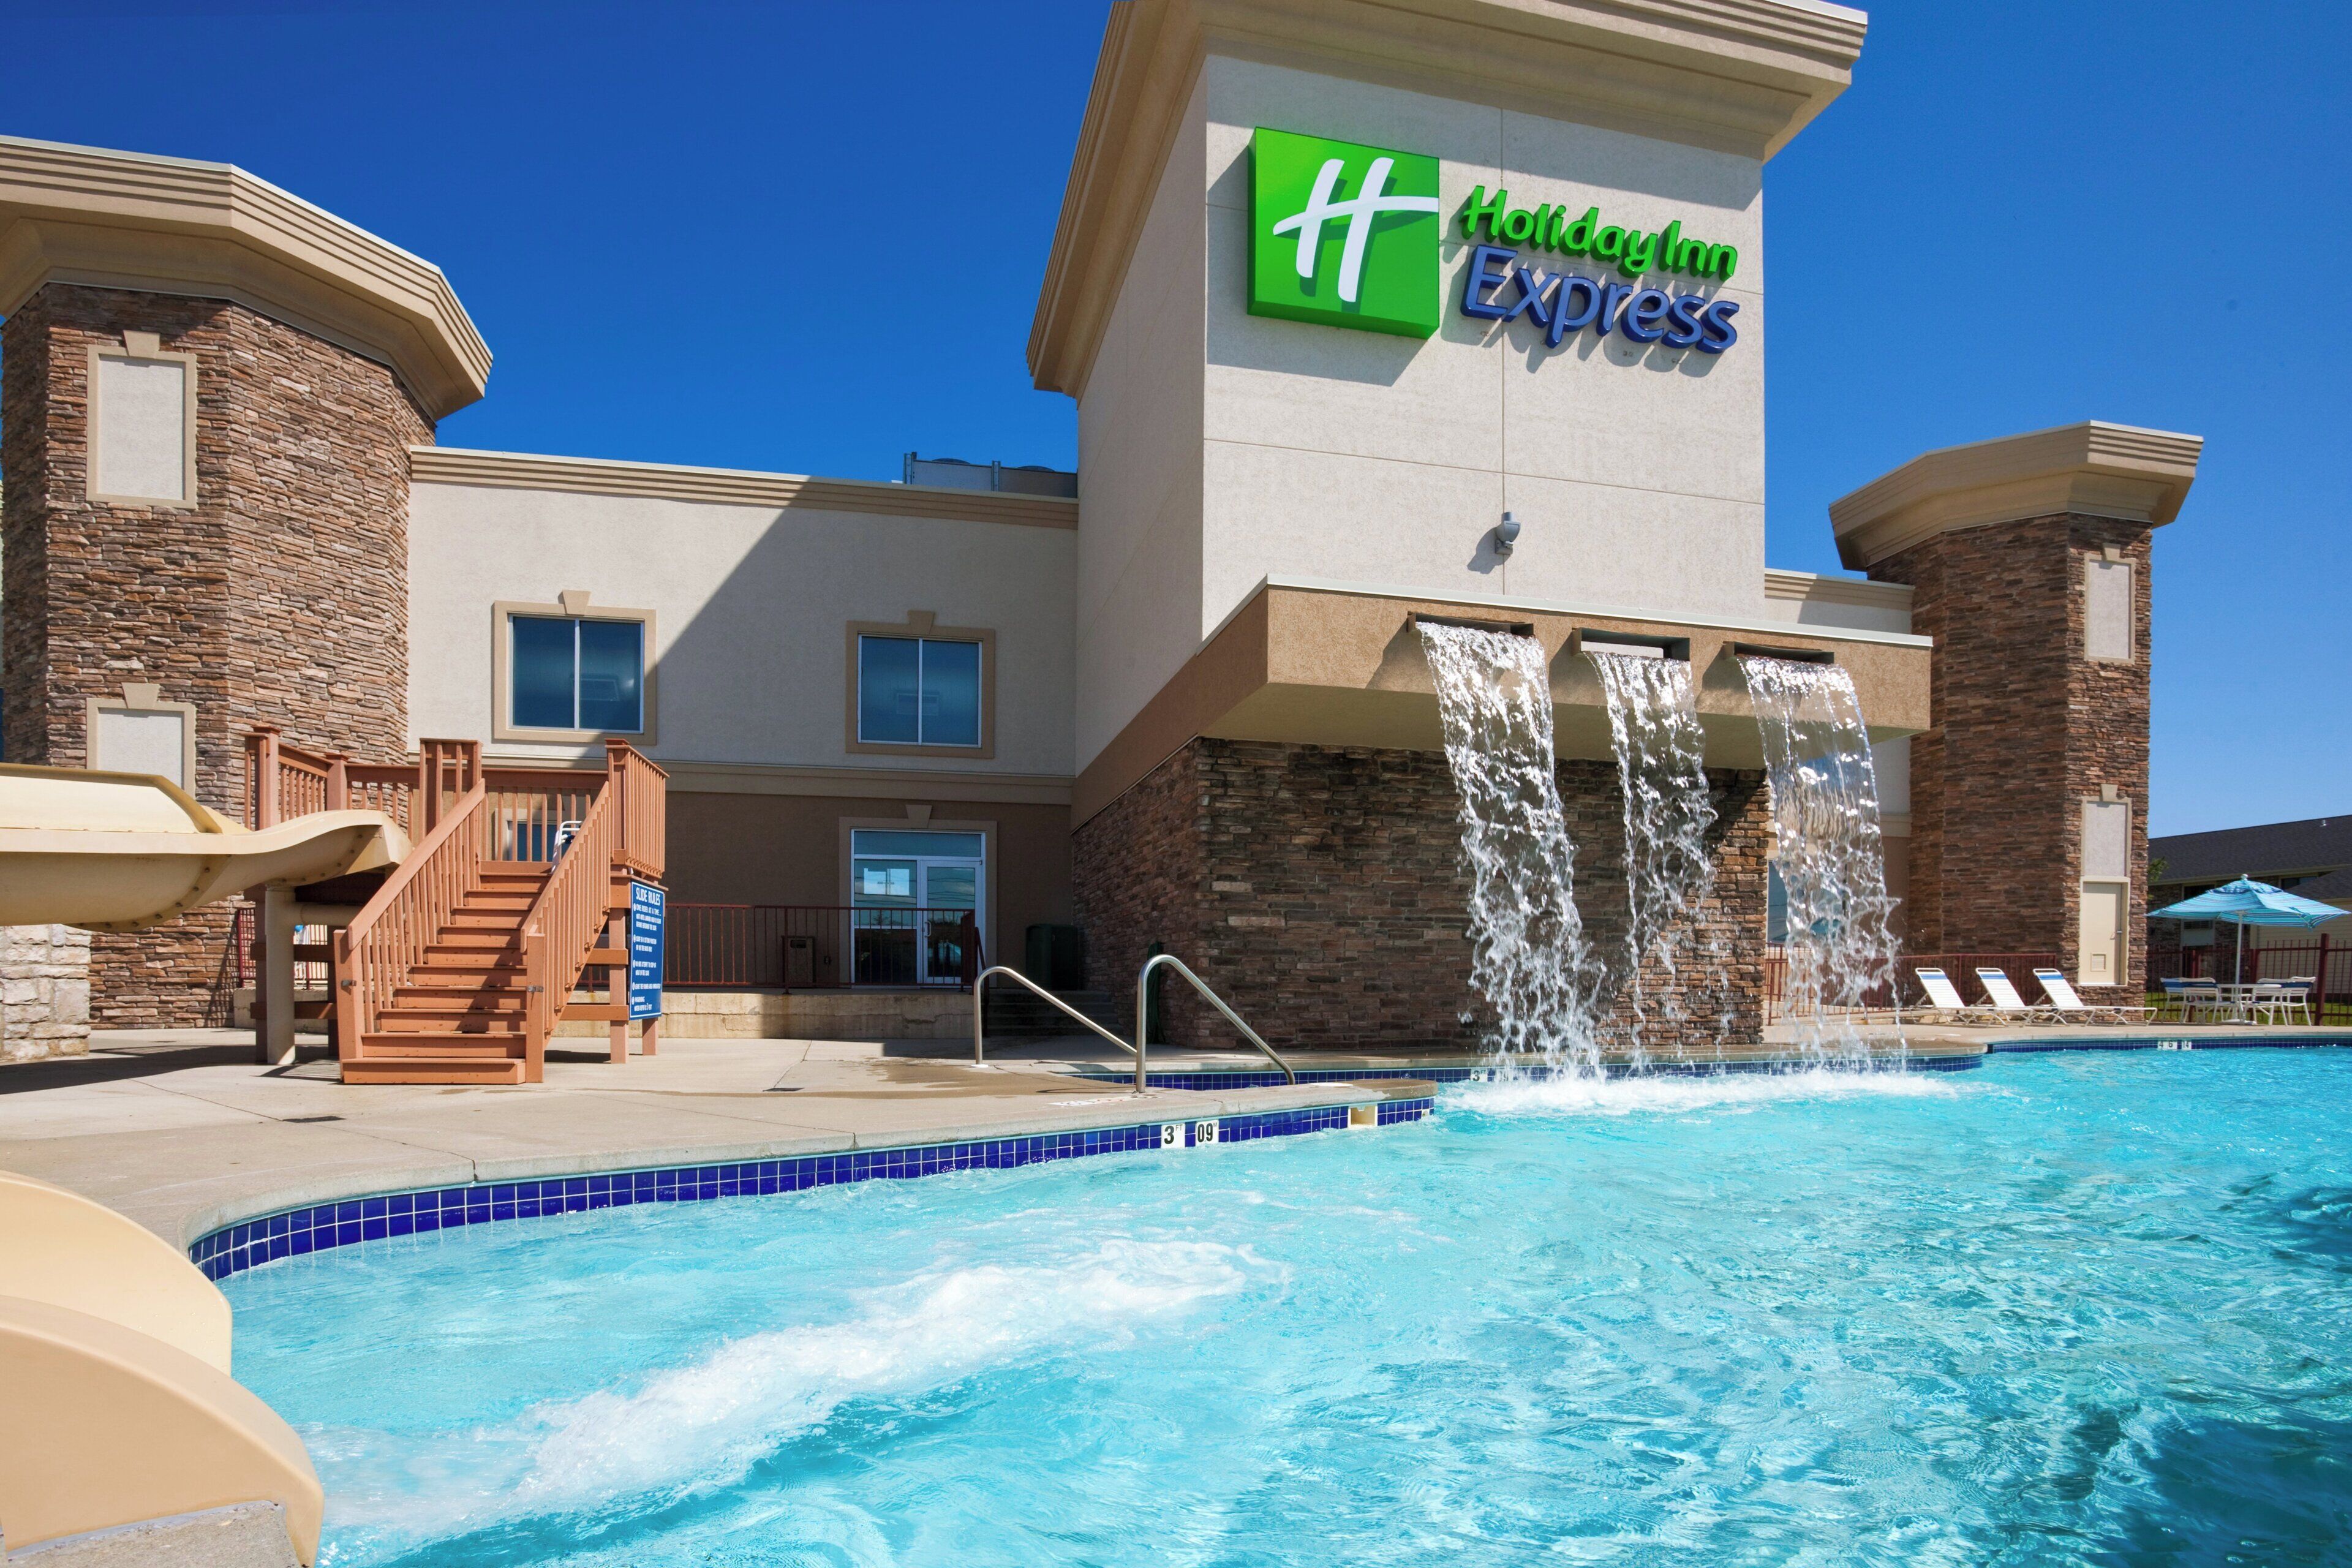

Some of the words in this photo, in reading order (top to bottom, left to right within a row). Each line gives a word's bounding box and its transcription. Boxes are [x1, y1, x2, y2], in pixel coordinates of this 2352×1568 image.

[1459, 186, 1659, 278] Holiday
[1658, 220, 1738, 282] Inn
[1460, 244, 1740, 355] Express
[636, 887, 647, 902] SLIDE
[648, 891, 661, 906] RULES
[2168, 1039, 2173, 1048] 6
[1472, 1070, 1480, 1082] 3
[1164, 1125, 1175, 1145] 3
